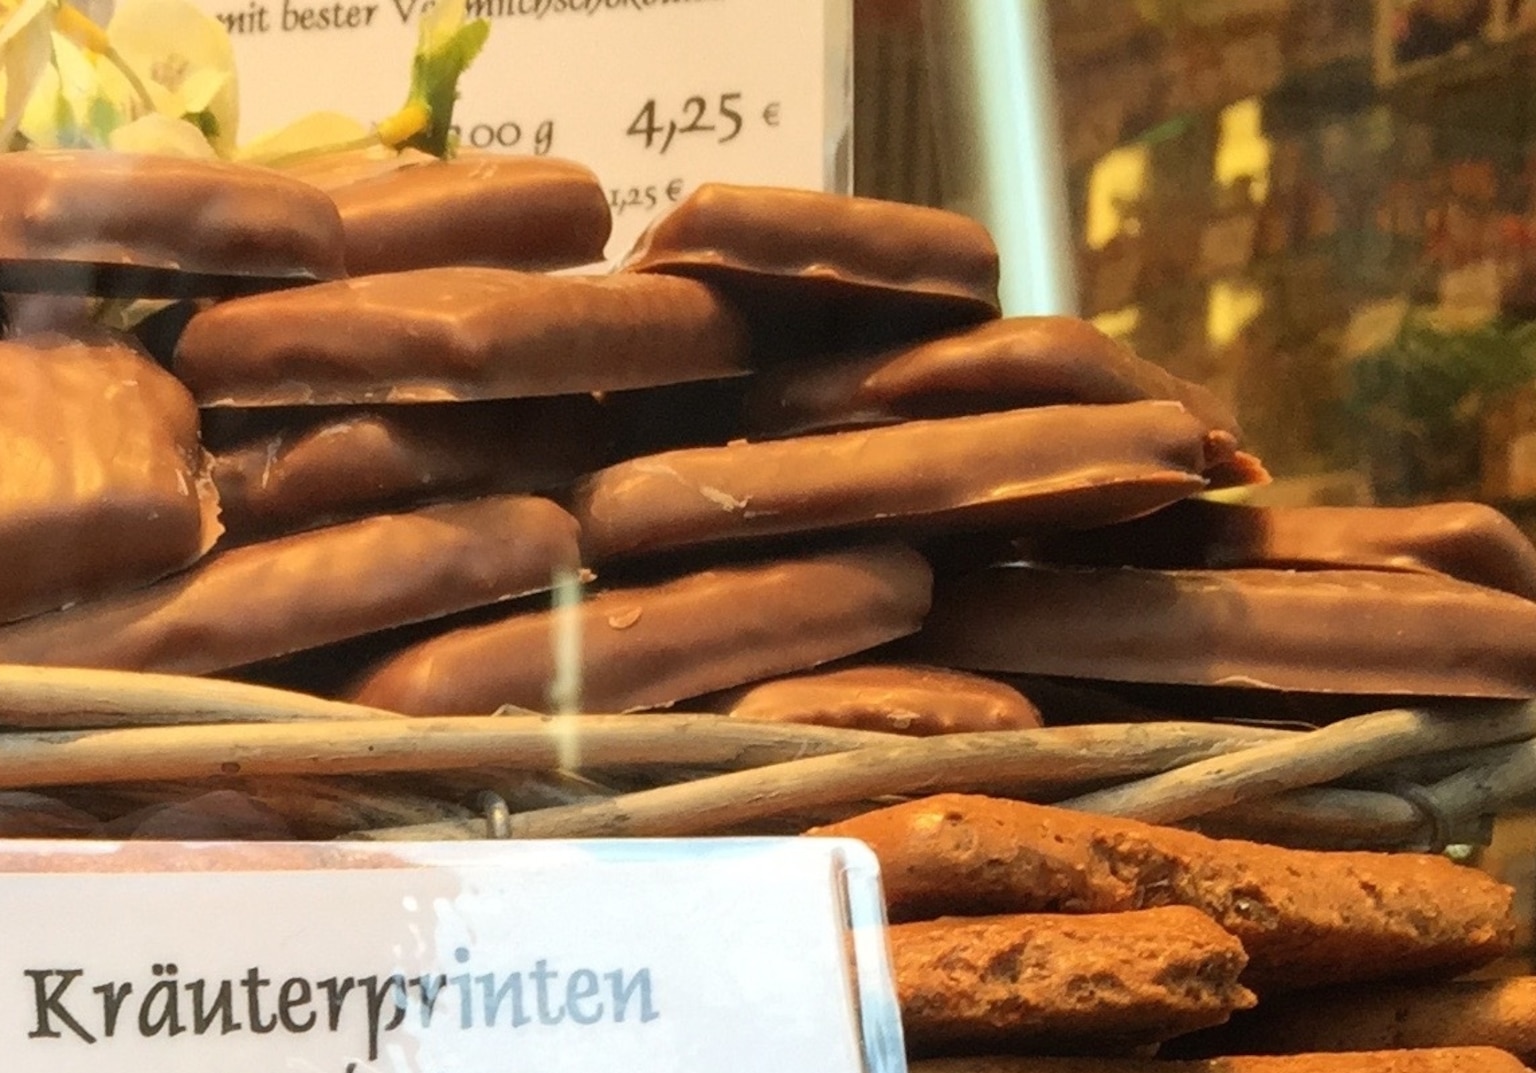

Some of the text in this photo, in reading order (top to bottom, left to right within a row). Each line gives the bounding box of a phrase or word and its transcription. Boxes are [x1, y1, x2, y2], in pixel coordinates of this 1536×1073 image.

[216, 1, 268, 34] mit
[281, 0, 379, 32] bester
[535, 120, 555, 156] g
[625, 92, 743, 156] 4,25
[762, 101, 781, 127] €
[665, 177, 684, 202] €
[24, 946, 661, 1060] Kräuterprinten
